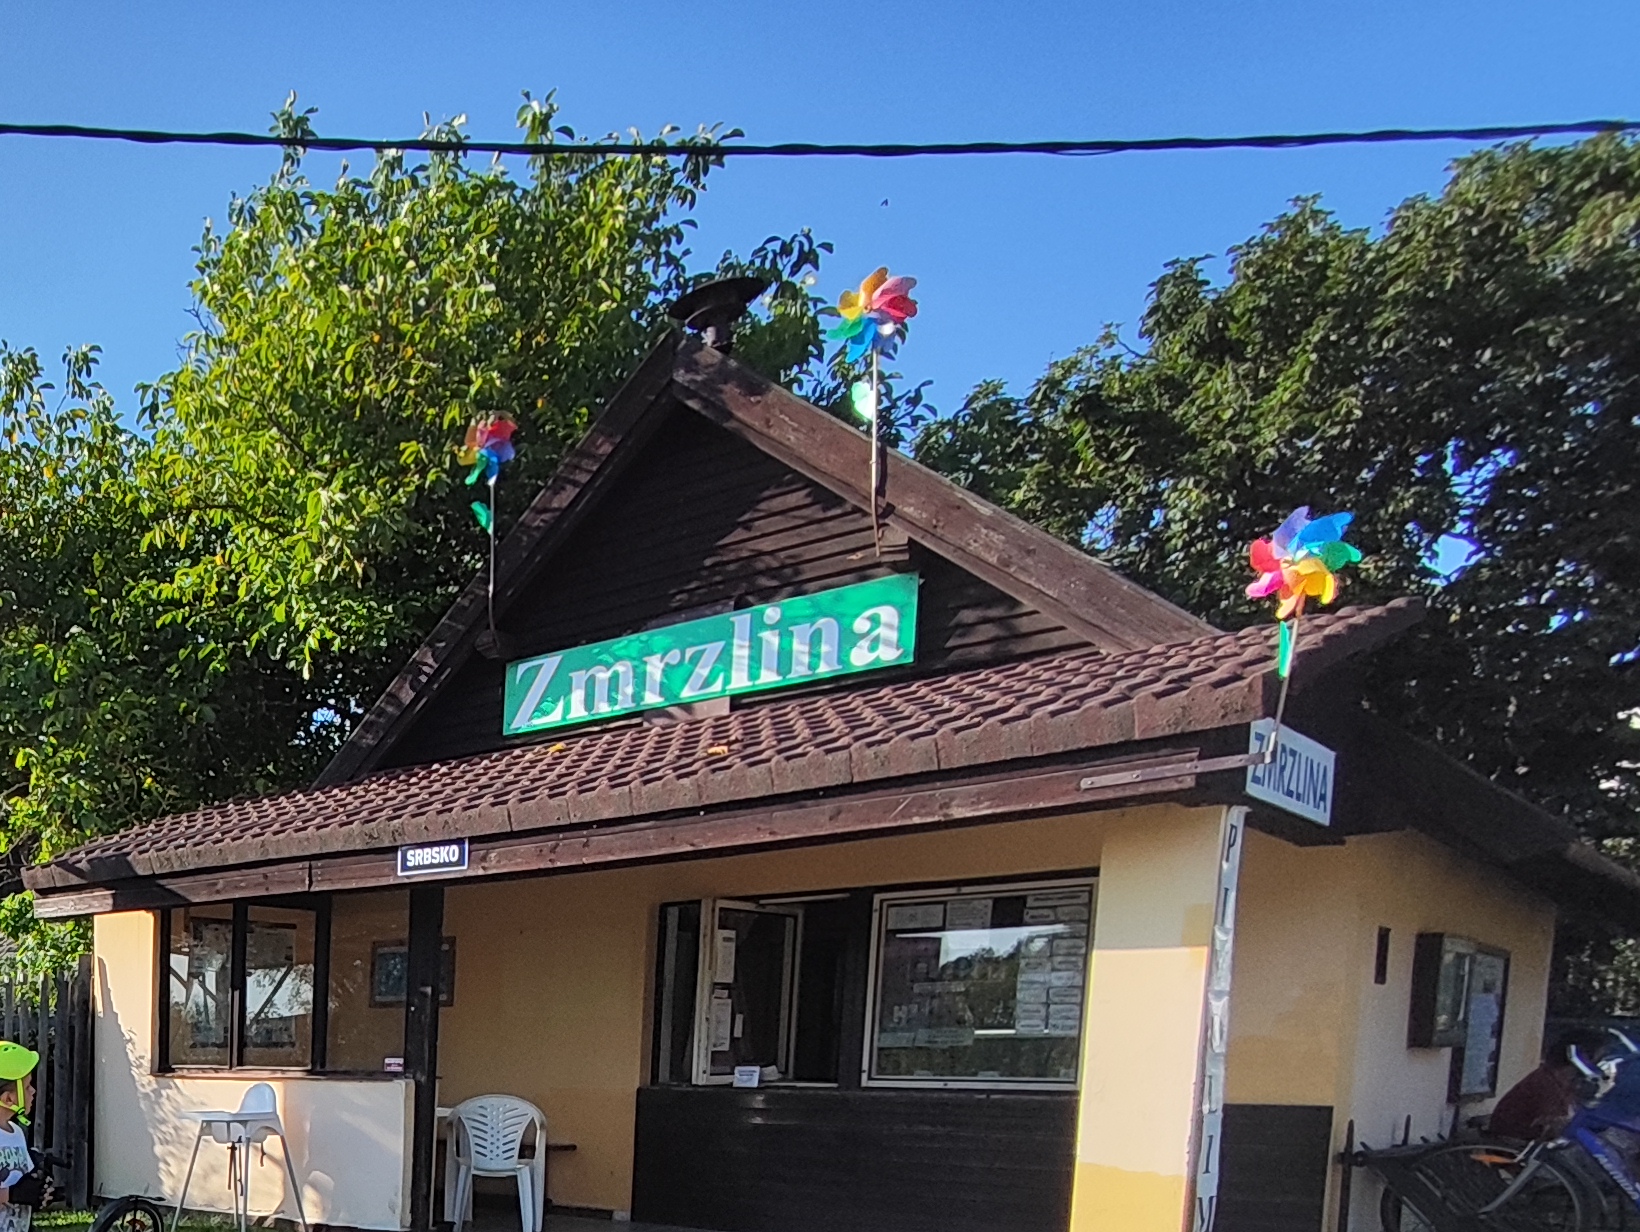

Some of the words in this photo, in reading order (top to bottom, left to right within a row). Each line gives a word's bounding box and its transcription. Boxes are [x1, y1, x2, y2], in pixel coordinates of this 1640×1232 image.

[509, 604, 904, 731] Zmrzlina
[1250, 731, 1328, 814] ZMRZLINA
[406, 844, 460, 867] SRBSKO
